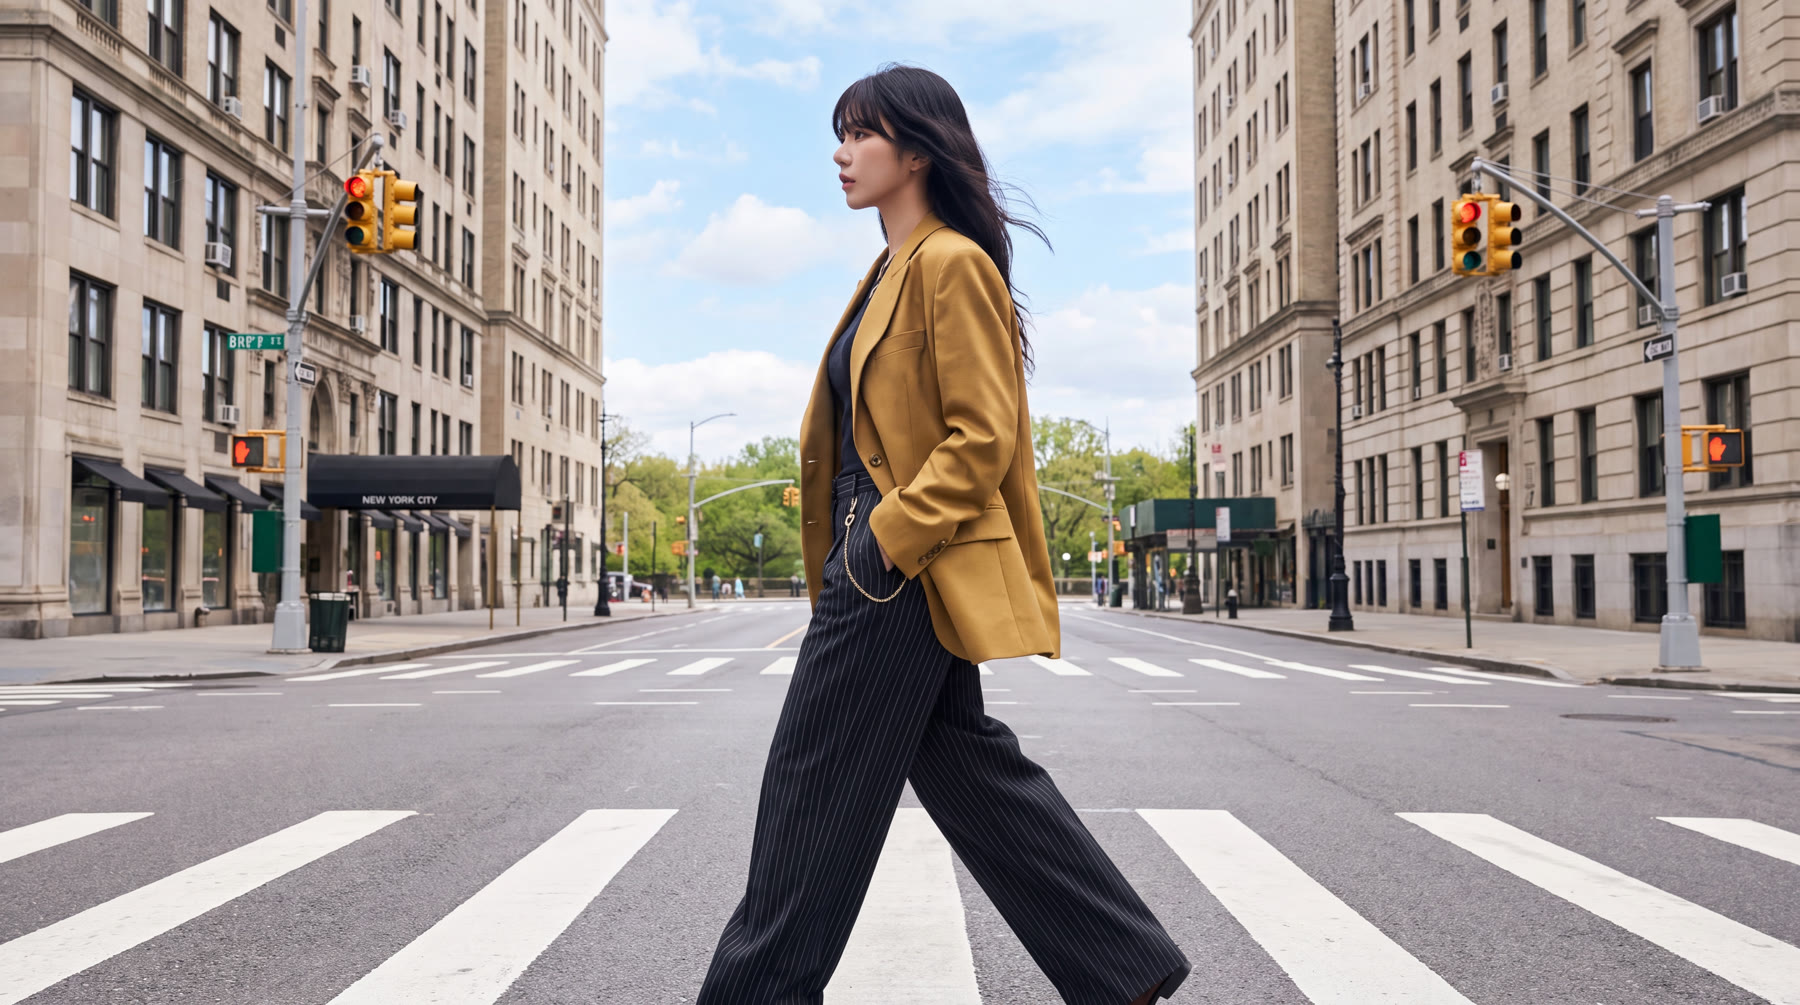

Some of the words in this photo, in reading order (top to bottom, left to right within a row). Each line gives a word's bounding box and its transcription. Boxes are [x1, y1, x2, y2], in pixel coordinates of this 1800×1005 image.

[362, 495, 386, 505] NEW
[388, 495, 415, 505] YORK
[417, 495, 438, 505] CITY
